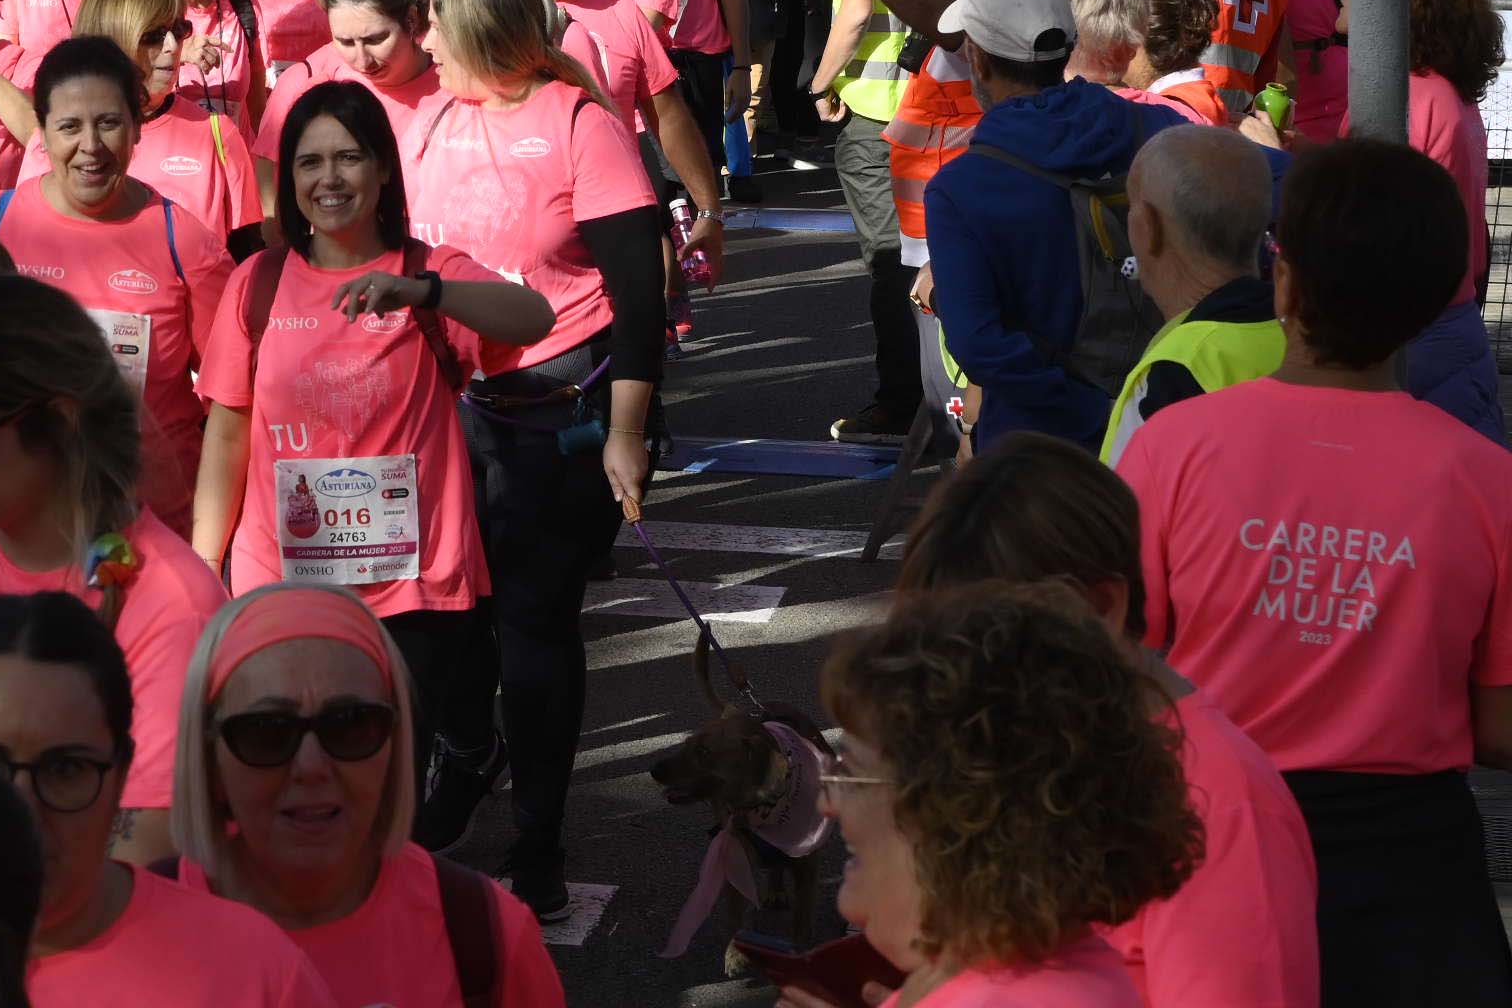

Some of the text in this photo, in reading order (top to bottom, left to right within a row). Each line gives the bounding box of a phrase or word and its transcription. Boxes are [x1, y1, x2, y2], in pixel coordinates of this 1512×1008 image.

[414, 224, 445, 249] TU
[113, 328, 139, 337] SUMA
[269, 423, 309, 452] TU
[381, 472, 407, 481] SUMA
[321, 479, 372, 491] ASTURIANA
[324, 508, 371, 527] 016
[329, 532, 367, 544] 24763
[1239, 518, 1416, 570] CARRERA
[359, 547, 386, 556] MUJER
[389, 546, 407, 554] 2023
[295, 566, 334, 576] OYSHO
[368, 562, 408, 573] Santander
[1268, 554, 1376, 598] DE LA
[1252, 588, 1379, 633] MUJER
[1299, 630, 1332, 645] 2023
